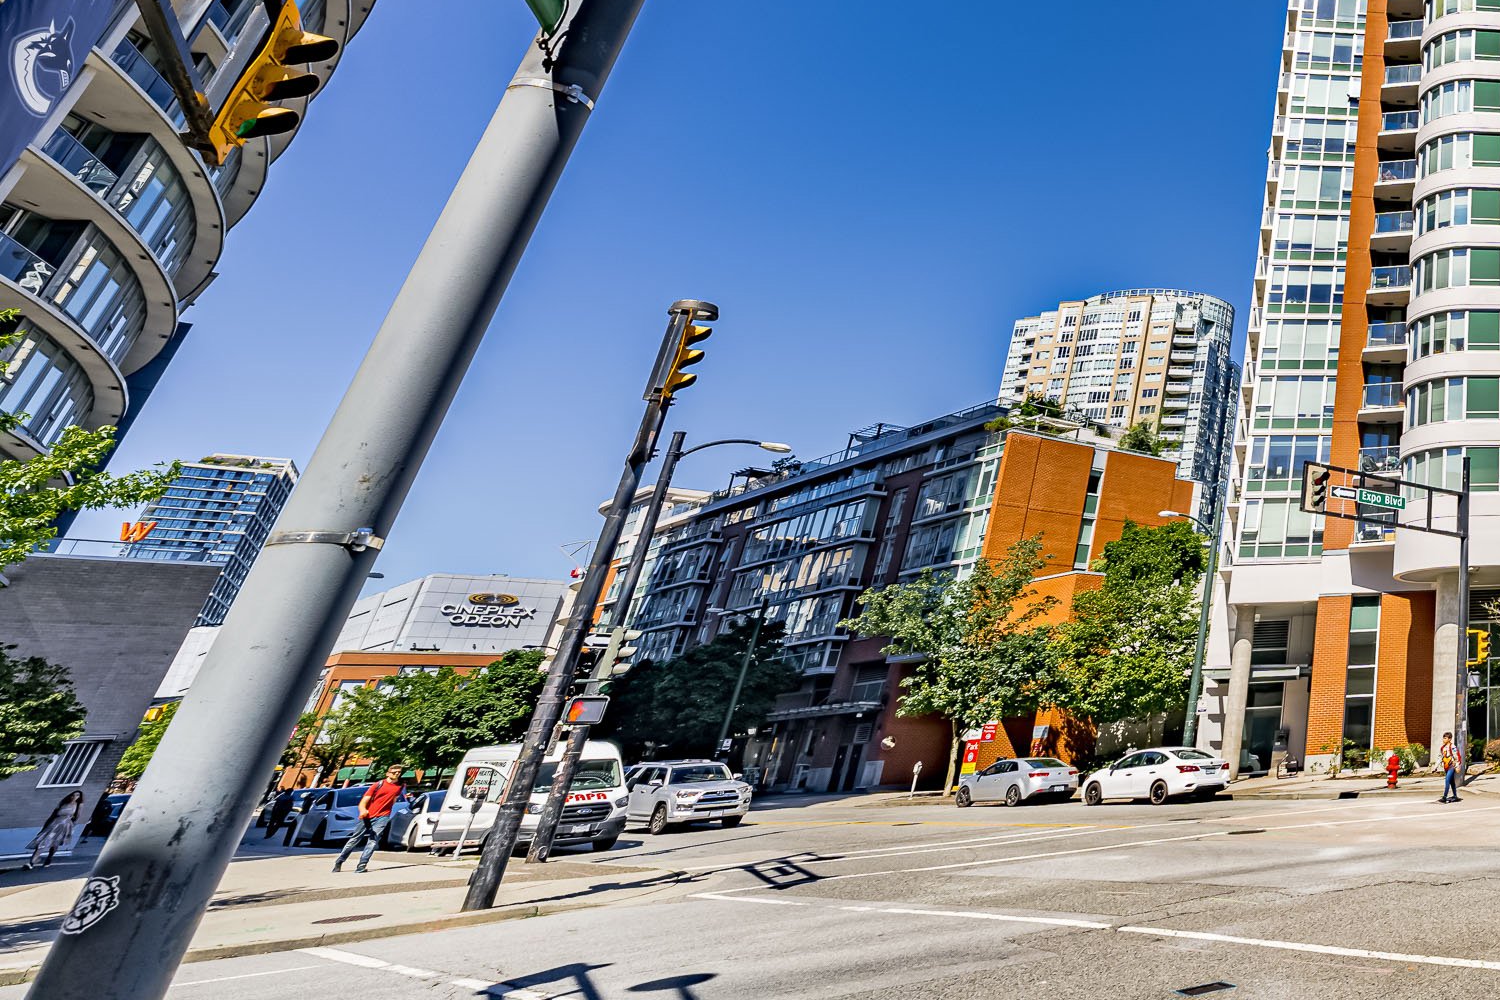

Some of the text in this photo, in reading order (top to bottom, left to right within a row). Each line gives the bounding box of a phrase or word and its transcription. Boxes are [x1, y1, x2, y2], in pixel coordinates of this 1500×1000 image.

[1362, 491, 1403, 507] Expo Blvd
[120, 521, 159, 543] W
[441, 603, 536, 619] CINEPLEX
[450, 614, 521, 627] ODEON
[966, 742, 979, 750] Park
